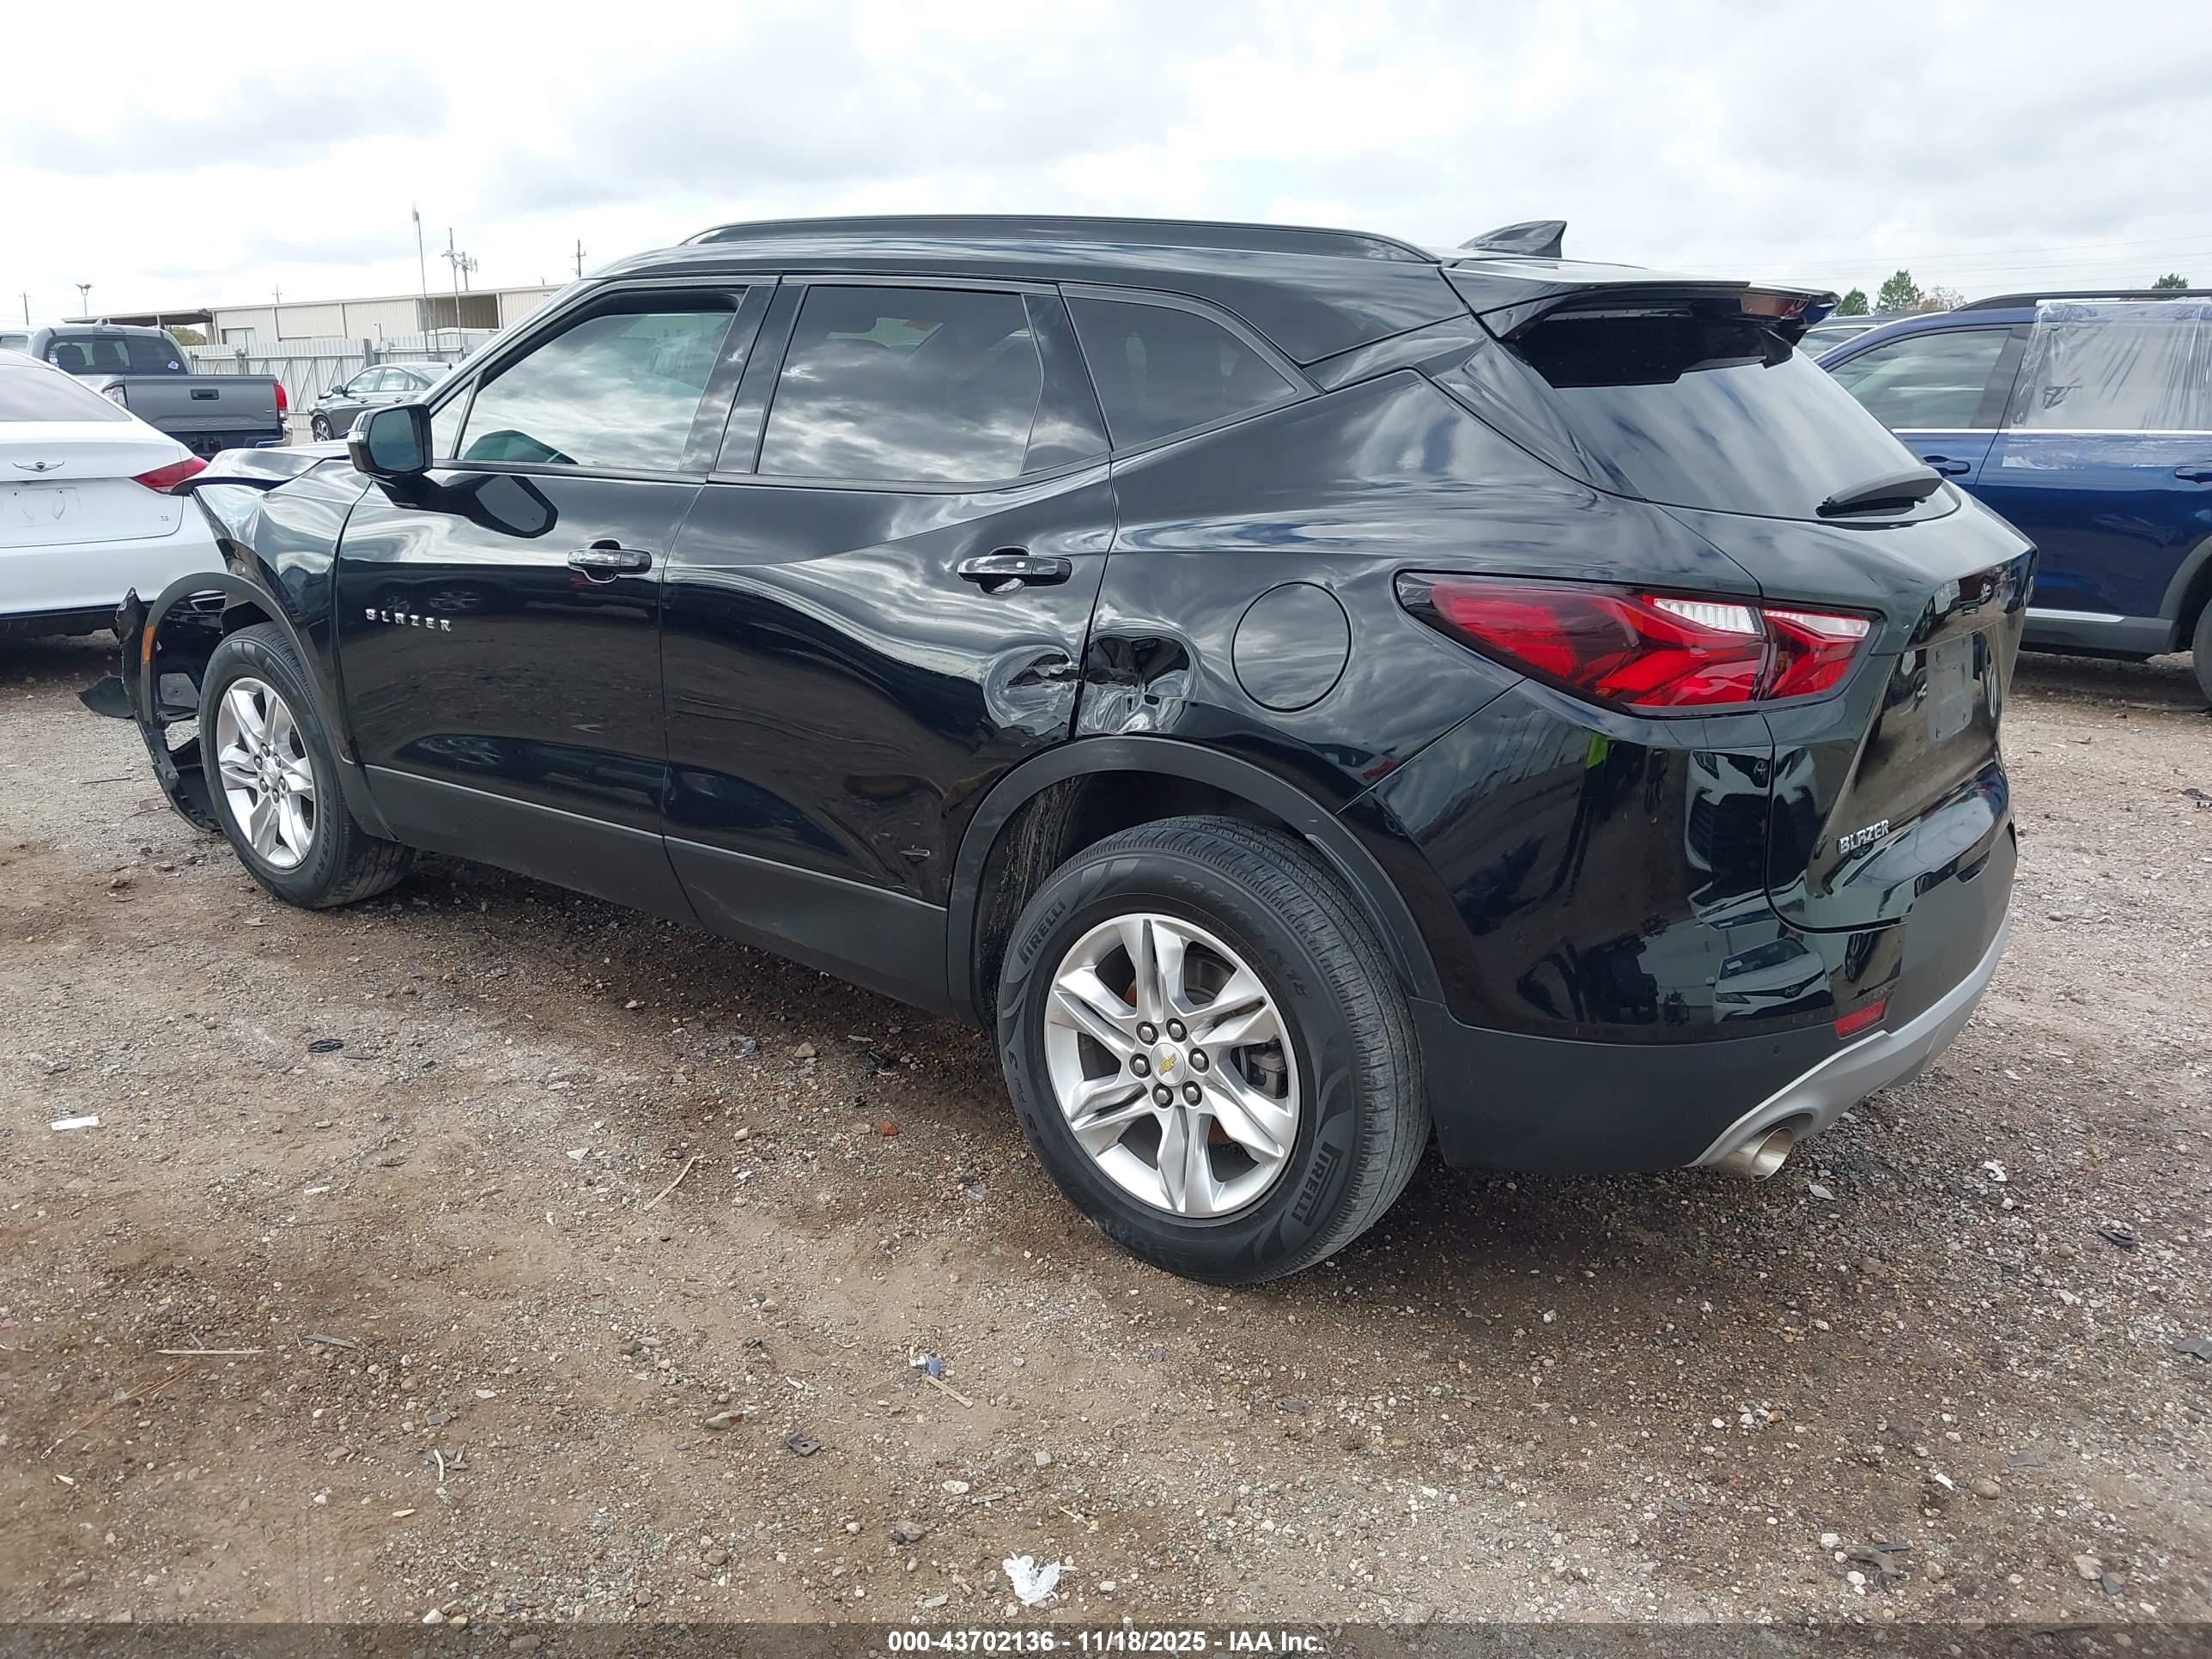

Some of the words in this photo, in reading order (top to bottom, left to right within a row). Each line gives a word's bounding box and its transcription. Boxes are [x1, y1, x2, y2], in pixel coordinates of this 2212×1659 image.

[364, 607, 453, 633] BLAZER
[1838, 818, 1890, 854] BLAZER
[1017, 891, 1067, 965] PIRELLI
[1291, 1140, 1344, 1227] PIRELLI
